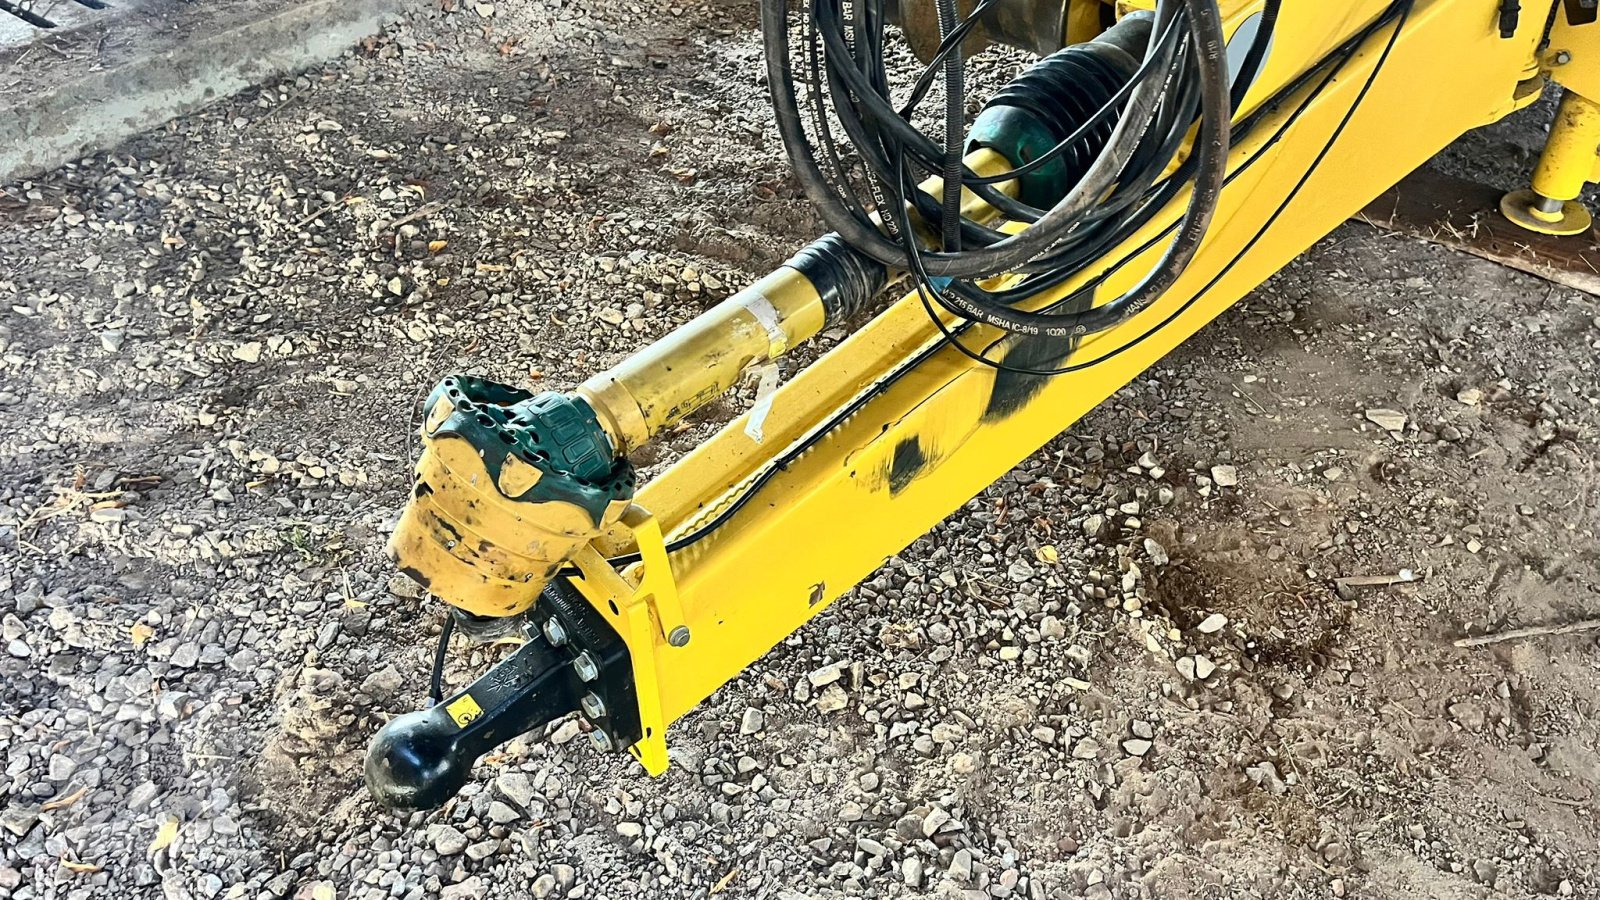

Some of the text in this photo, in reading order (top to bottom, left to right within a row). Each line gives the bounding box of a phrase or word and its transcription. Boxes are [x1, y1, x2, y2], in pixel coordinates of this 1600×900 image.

[841, 1, 853, 20] BAR
[815, 122, 823, 136] BAR
[880, 209, 893, 222] HD
[886, 221, 899, 235] 220
[954, 297, 968, 309] 215
[966, 303, 984, 318] BAR
[986, 314, 1011, 329] MSHA
[1011, 322, 1039, 335] IC-8/19
[1045, 327, 1067, 337] 1Q20
